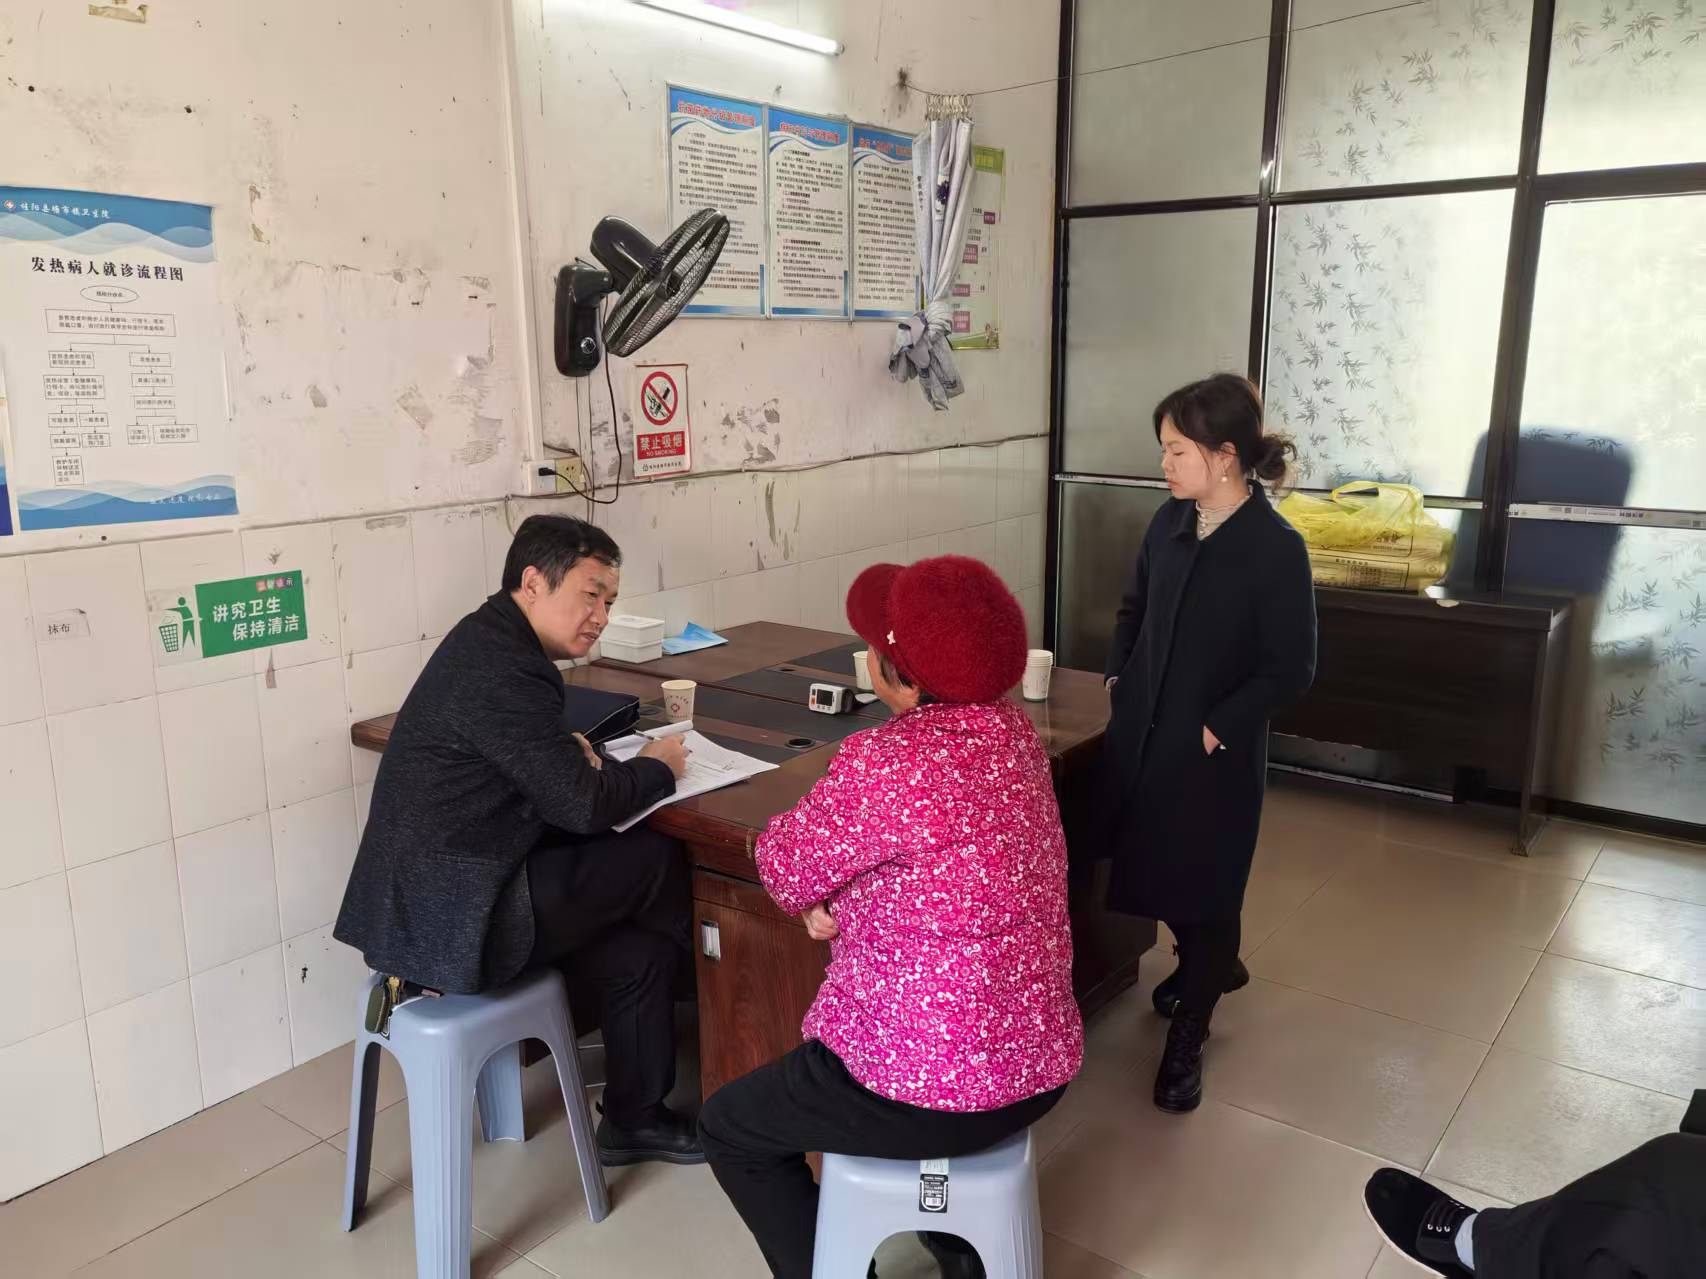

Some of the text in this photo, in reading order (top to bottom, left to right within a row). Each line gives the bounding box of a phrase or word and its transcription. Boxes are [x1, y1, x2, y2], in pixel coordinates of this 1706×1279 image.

[31, 256, 184, 281] 发热病人就诊流程图
[640, 433, 682, 451] 禁止吸烟
[212, 596, 281, 623] 讲究卫生
[232, 614, 300, 642] 保持清洁
